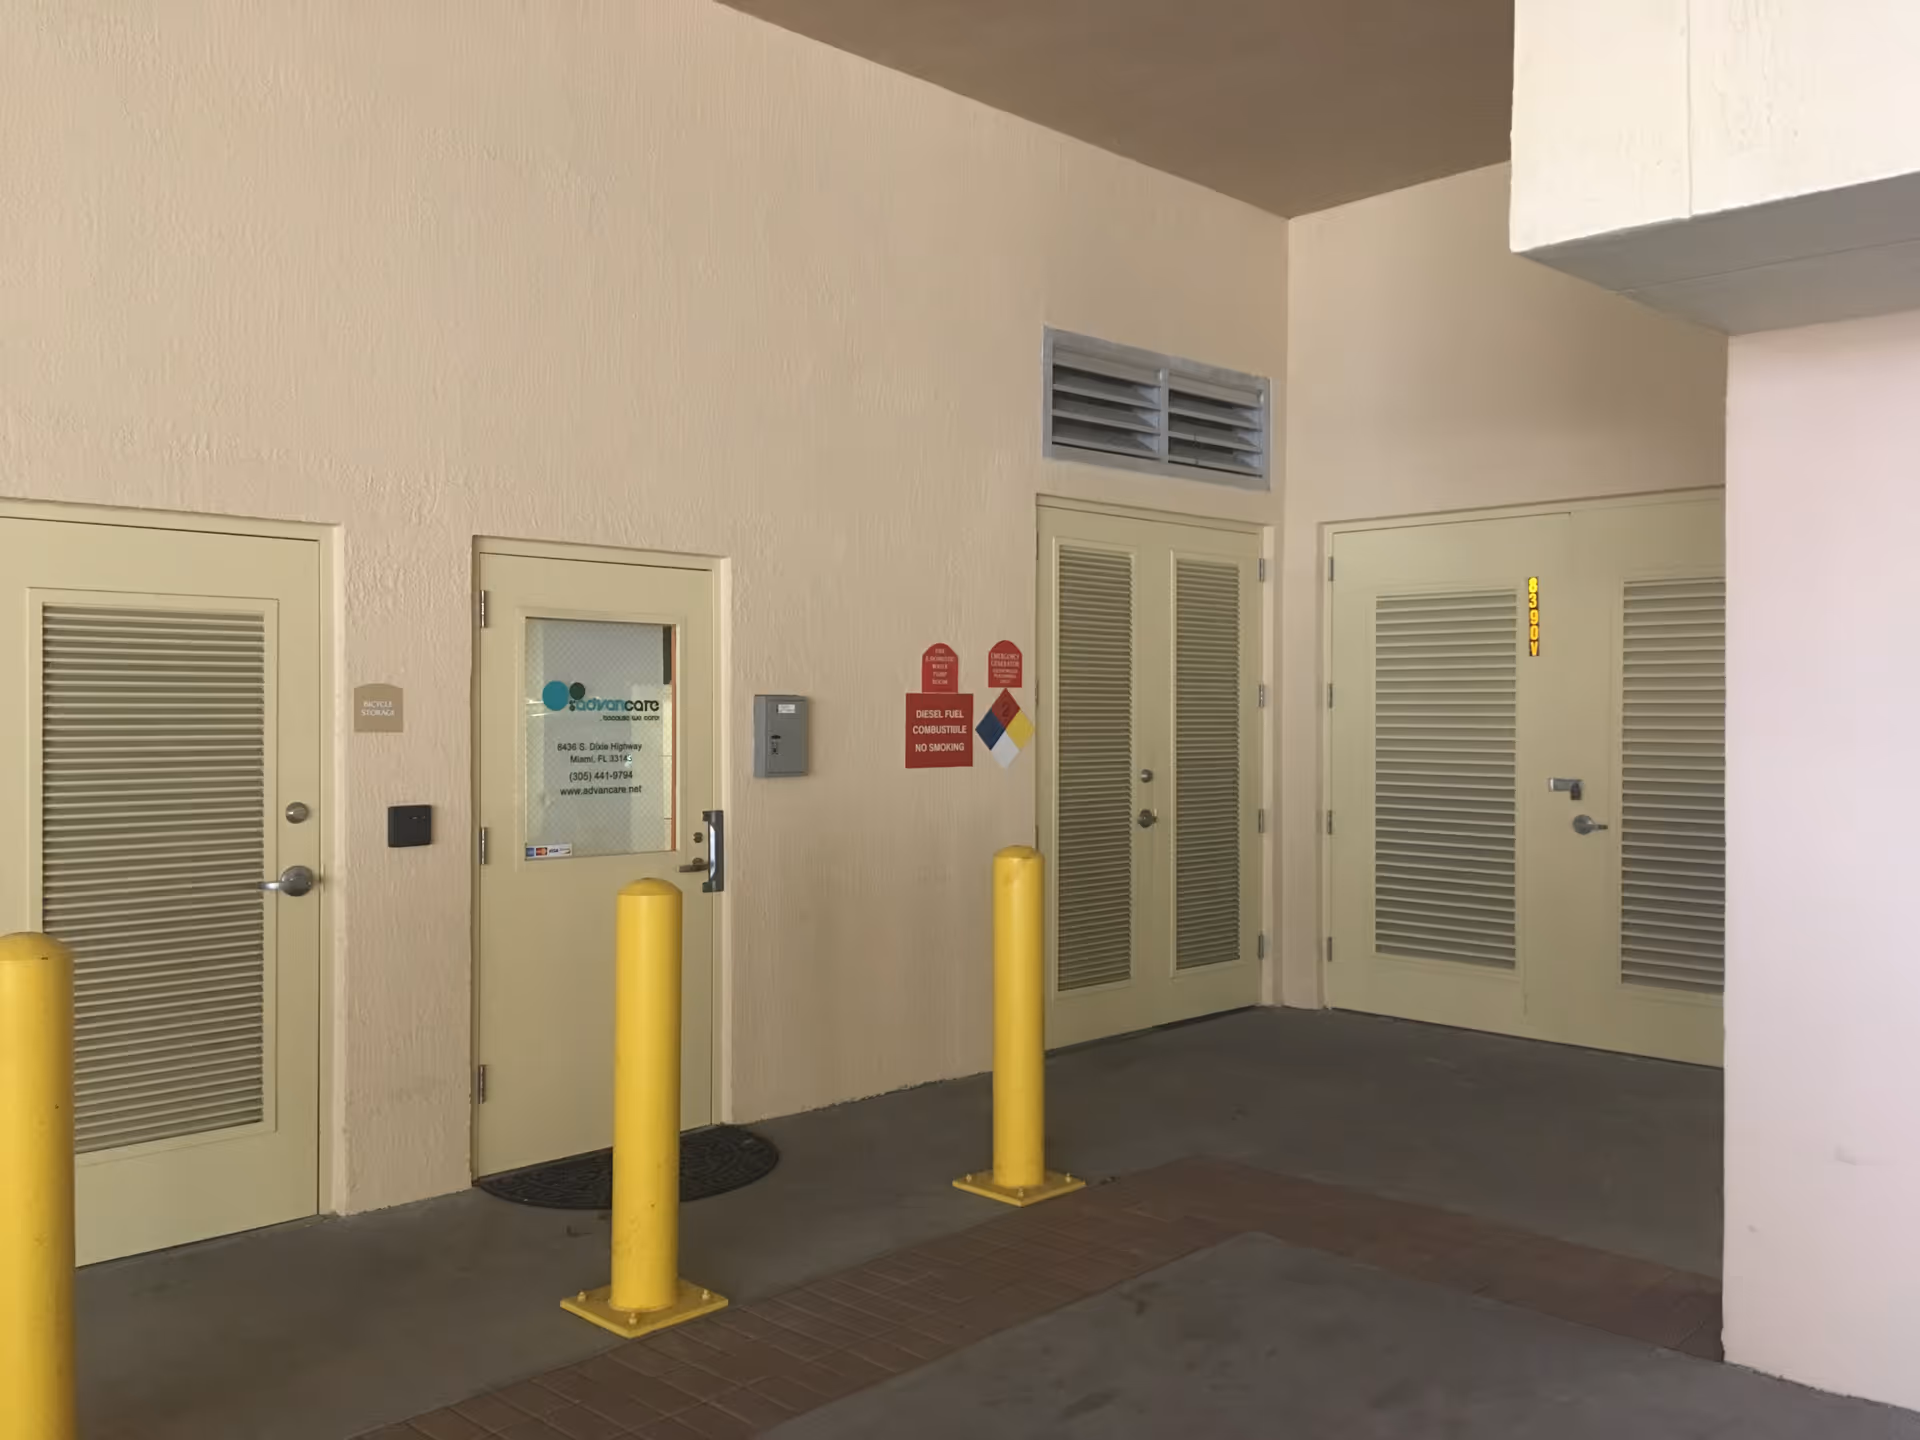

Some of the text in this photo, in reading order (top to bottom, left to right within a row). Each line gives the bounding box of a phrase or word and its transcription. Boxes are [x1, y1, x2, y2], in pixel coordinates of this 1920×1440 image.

[361, 709, 395, 717] STORAGE
[915, 709, 965, 719] DIESEL FUEL
[912, 724, 967, 735] COMBUSTIBLE
[589, 742, 609, 751] Dixie
[610, 742, 643, 752] Highway
[914, 742, 965, 753] NO SMOKING
[597, 754, 607, 763] FL
[569, 770, 633, 783] (305) 441-9794
[560, 785, 642, 796] www.advancare.net
